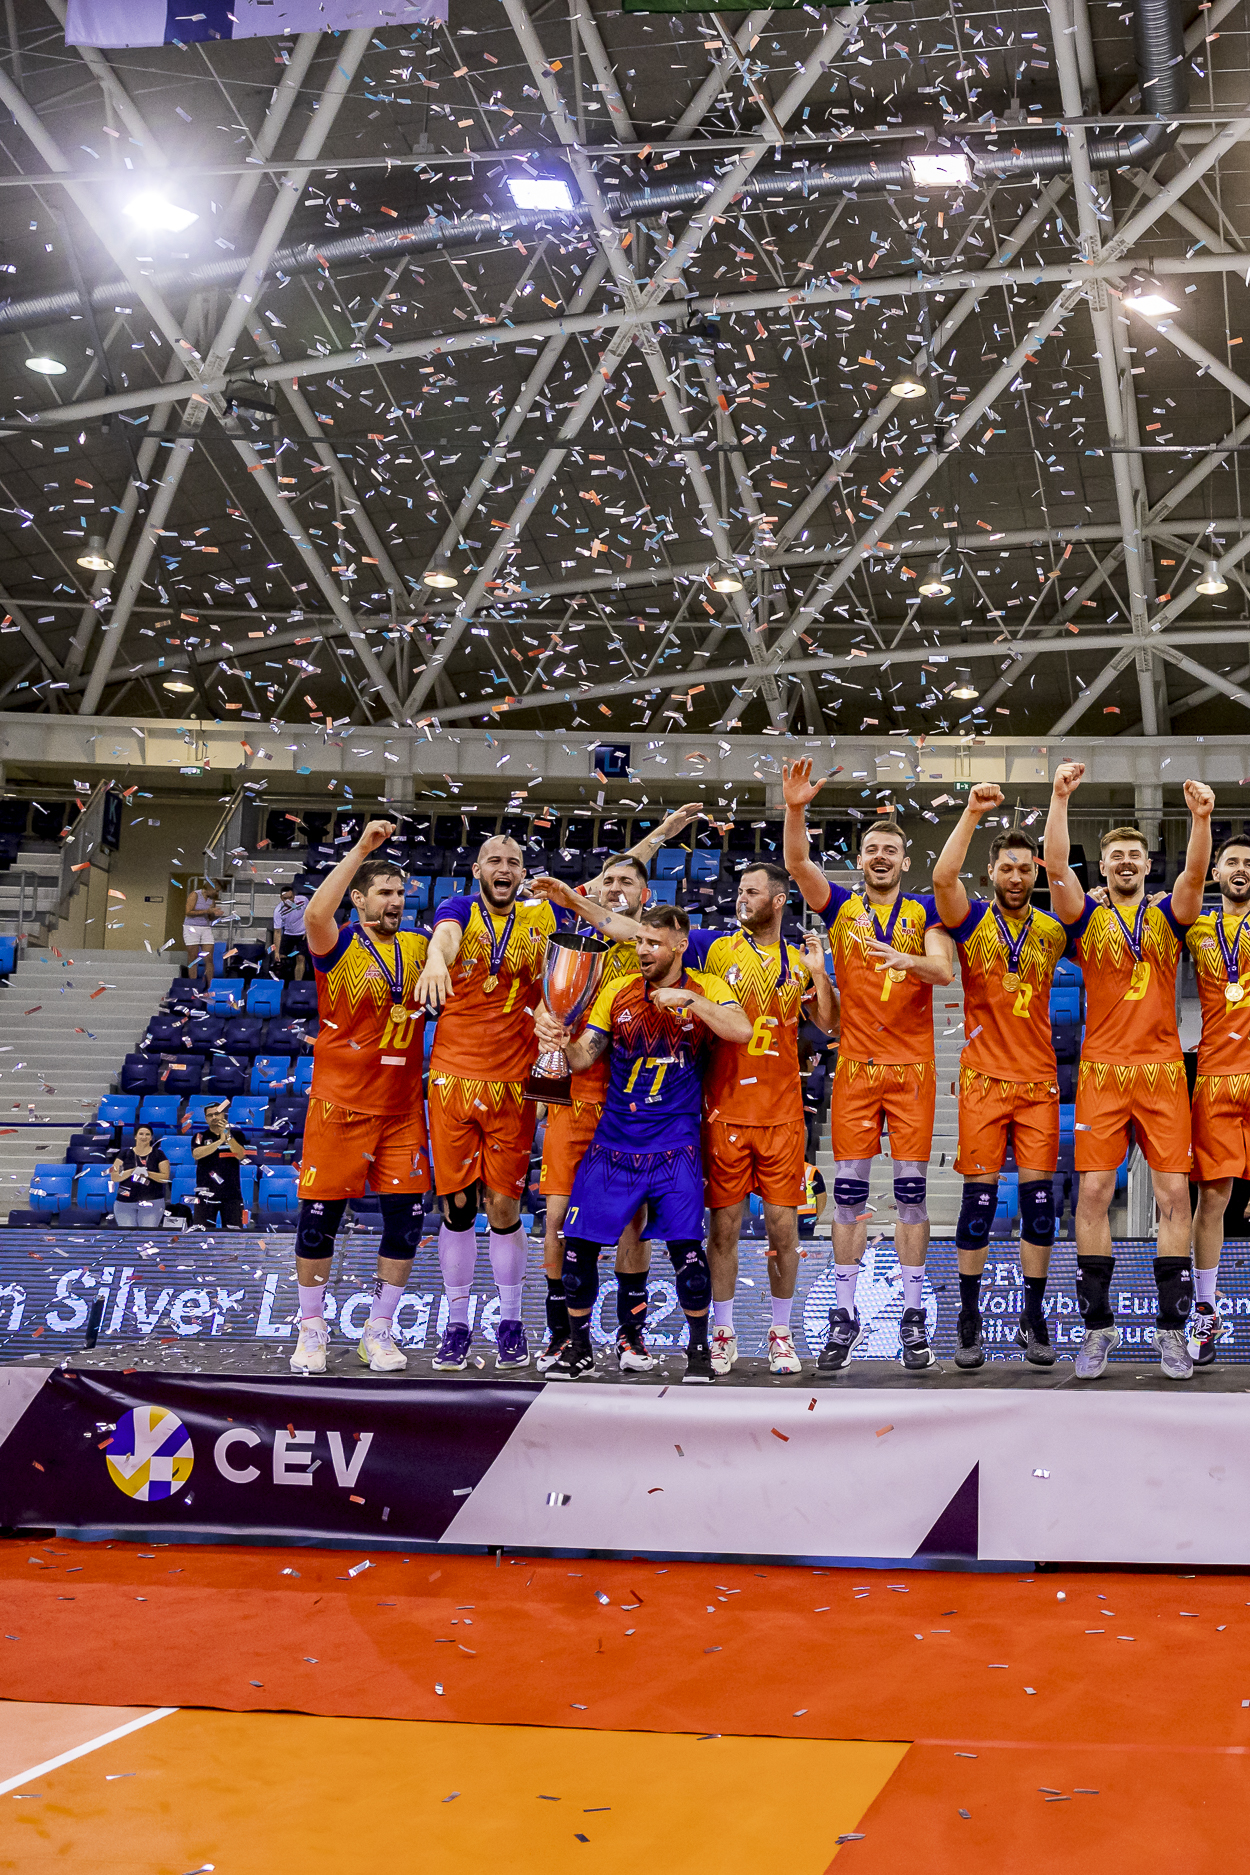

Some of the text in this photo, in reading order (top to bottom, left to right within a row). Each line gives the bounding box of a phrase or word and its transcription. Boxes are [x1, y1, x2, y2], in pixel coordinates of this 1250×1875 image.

[604, 750, 620, 772] L
[109, 796, 118, 823] K
[1124, 961, 1151, 1001] 9
[379, 1009, 416, 1049] 10
[747, 1015, 777, 1056] 6
[623, 1056, 670, 1096] 17
[301, 1169, 316, 1187] 10
[45, 1266, 246, 1336] Silver
[213, 1427, 374, 1488] CEV
